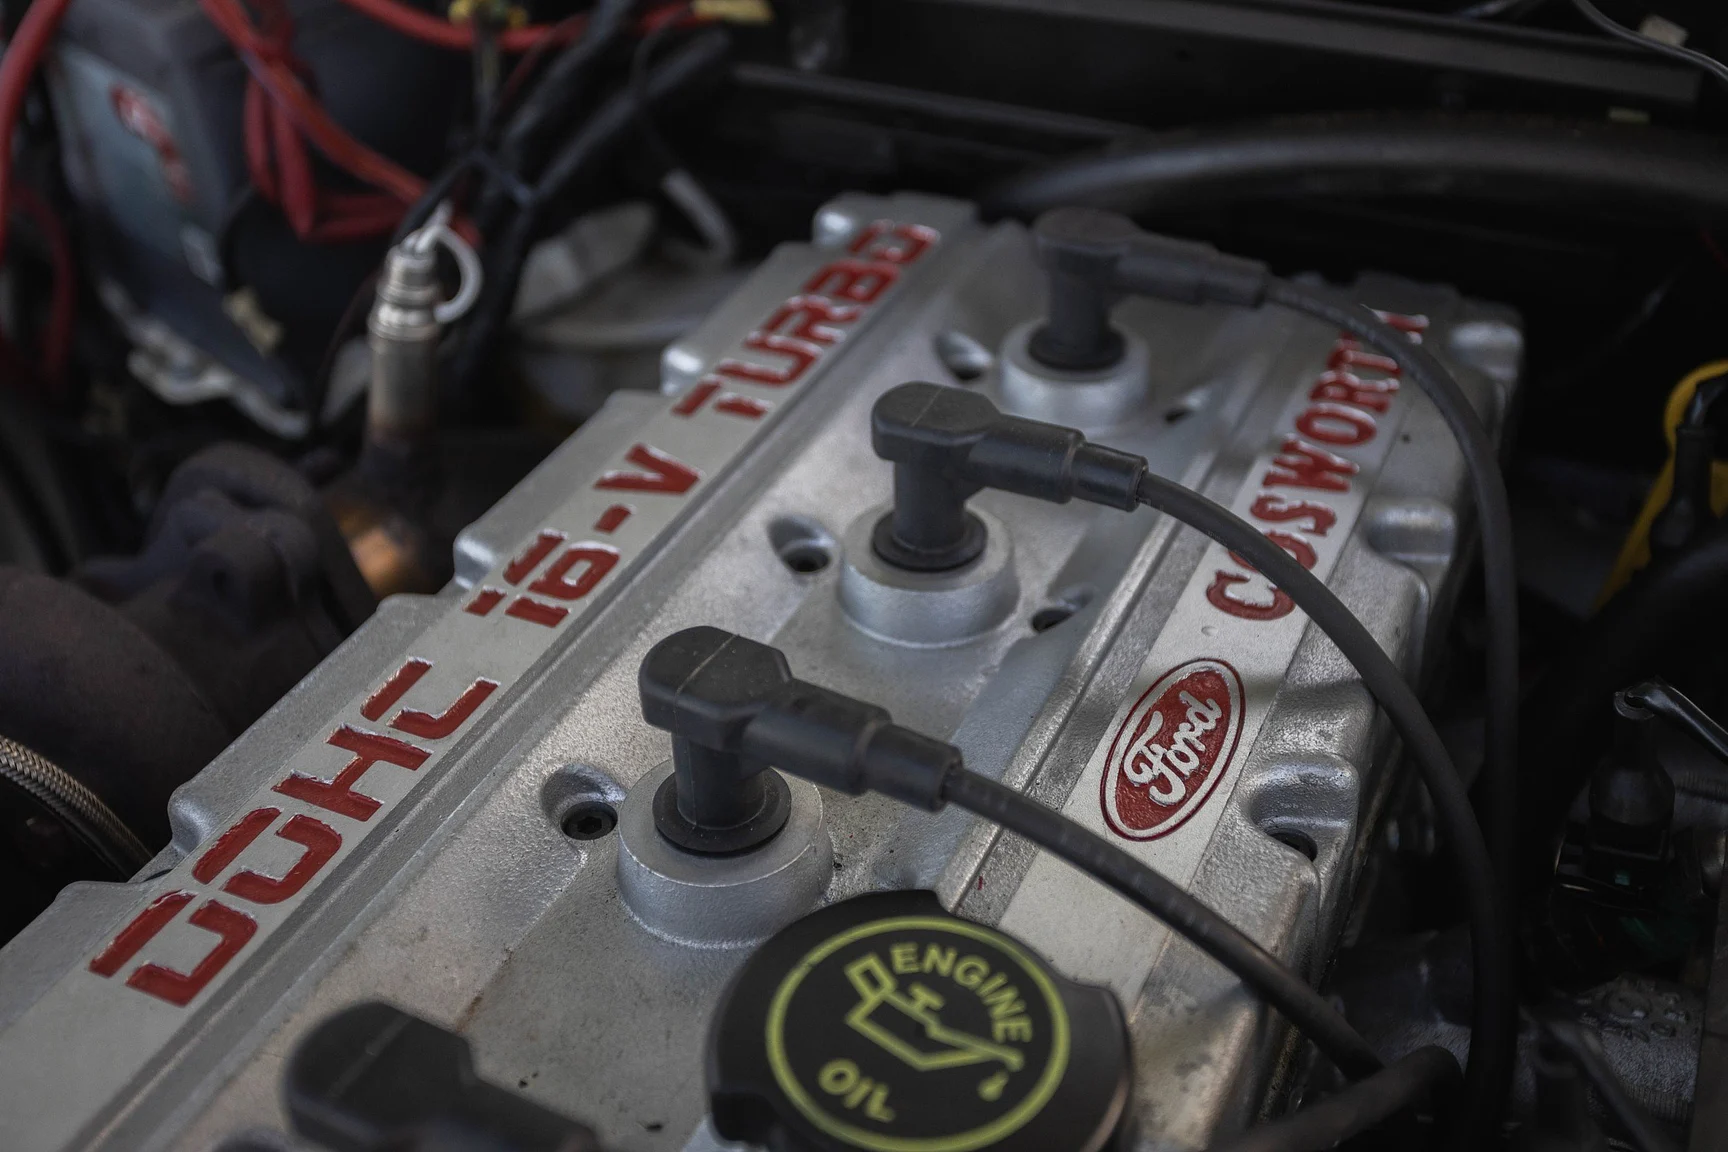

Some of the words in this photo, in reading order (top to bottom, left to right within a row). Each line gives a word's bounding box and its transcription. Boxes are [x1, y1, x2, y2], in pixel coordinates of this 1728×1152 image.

[88, 656, 500, 1008] DOHC
[464, 443, 700, 628] 16-V
[671, 219, 938, 420] TURBO
[1123, 690, 1223, 807] Ford
[890, 942, 1033, 1042] ENGINE
[818, 1058, 896, 1123] OIL
